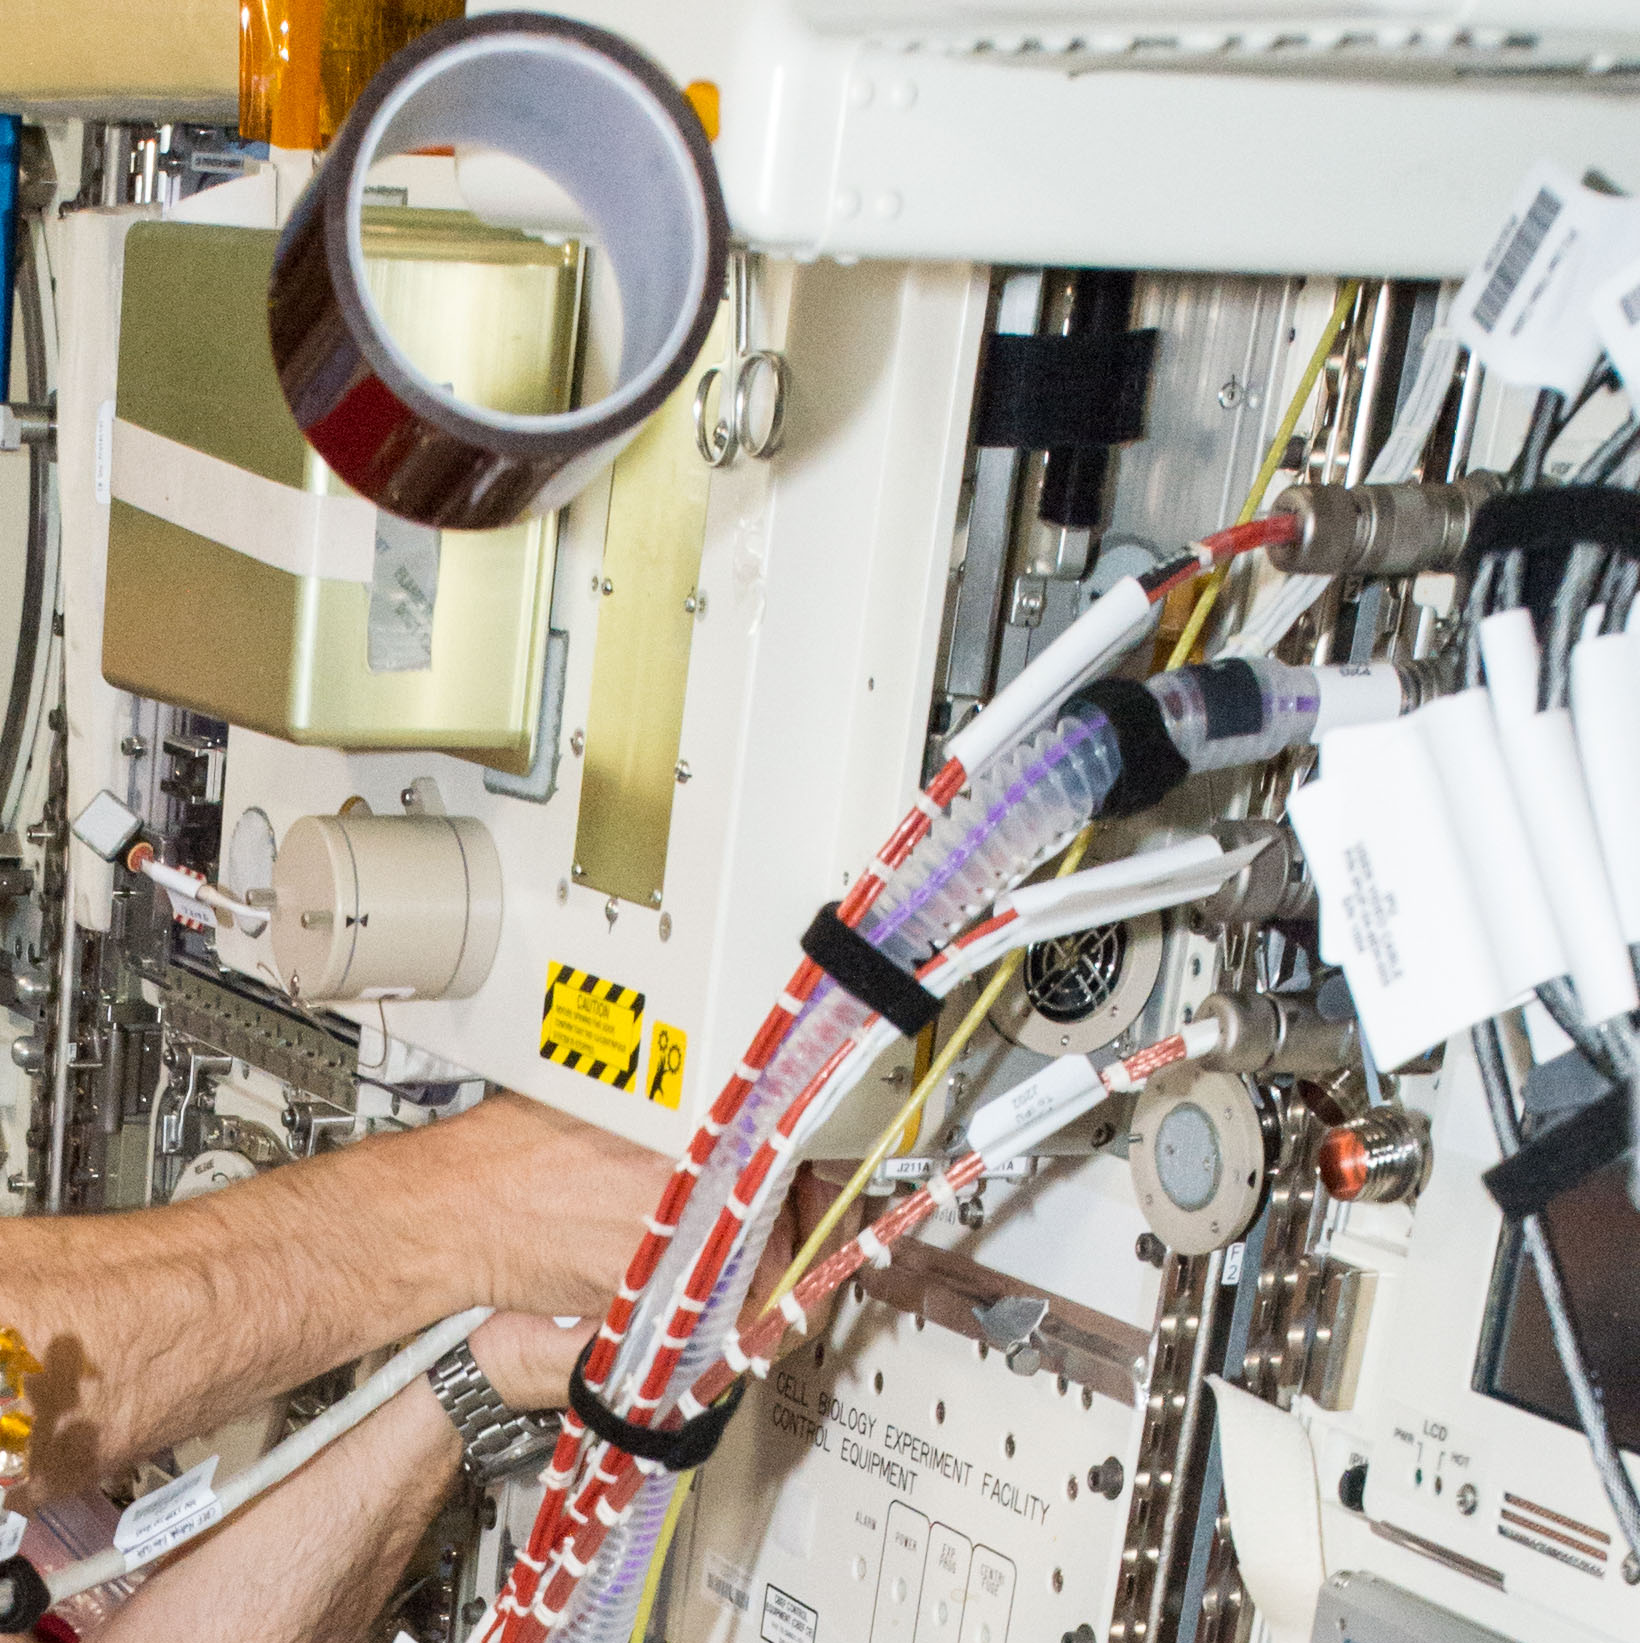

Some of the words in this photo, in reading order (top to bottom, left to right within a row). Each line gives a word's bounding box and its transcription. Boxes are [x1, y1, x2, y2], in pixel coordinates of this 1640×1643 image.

[576, 992, 611, 1019] CAUTION
[897, 1160, 929, 1173] J211A
[1230, 1244, 1241, 1261] F
[1226, 1263, 1237, 1280] 2
[1421, 1417, 1448, 1445] LCD
[769, 1402, 833, 1453] CONTROL
[839, 1437, 918, 1495] EQUIPMENT
[774, 1369, 813, 1408] CELL
[816, 1390, 876, 1439] BIOLOGY
[883, 1423, 973, 1487] EXPERIMENT
[979, 1471, 1050, 1527] FACILITY
[854, 1509, 877, 1532] ALARM
[894, 1530, 918, 1553] POWER
